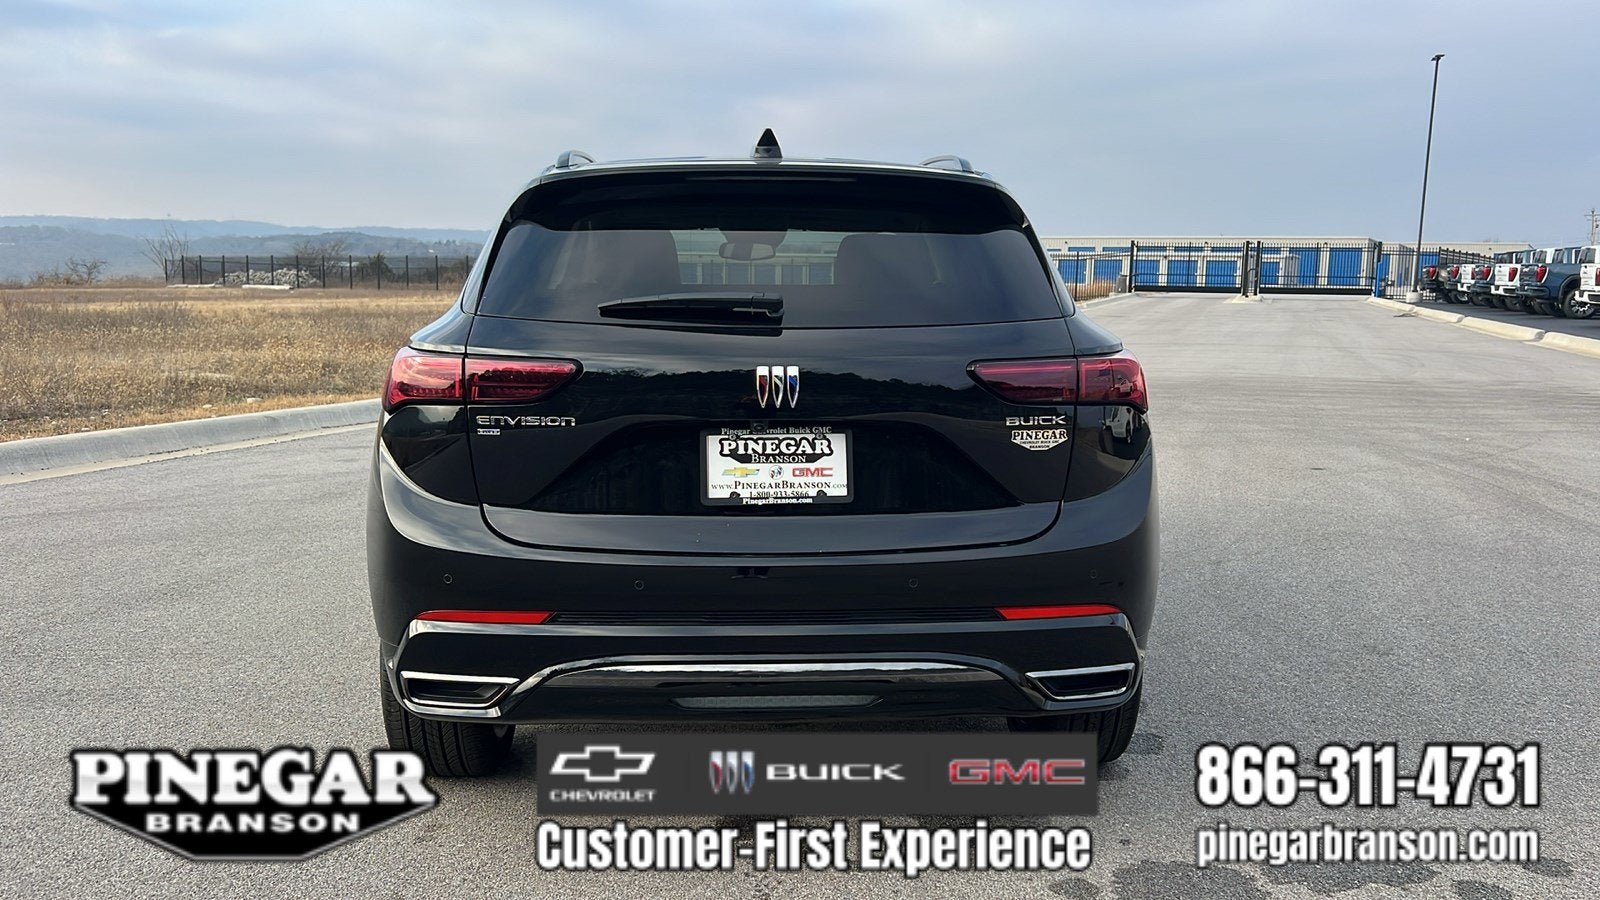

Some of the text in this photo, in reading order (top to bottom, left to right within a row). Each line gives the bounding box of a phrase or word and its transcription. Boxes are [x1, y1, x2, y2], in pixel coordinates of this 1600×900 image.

[476, 416, 576, 426] ENVISION
[1006, 415, 1067, 426] BUICK
[812, 426, 832, 434] GMC
[1013, 430, 1066, 440] PINEGAR
[721, 440, 831, 455] PINEGAR
[751, 454, 806, 463] BRANSON
[792, 467, 833, 477] GMC
